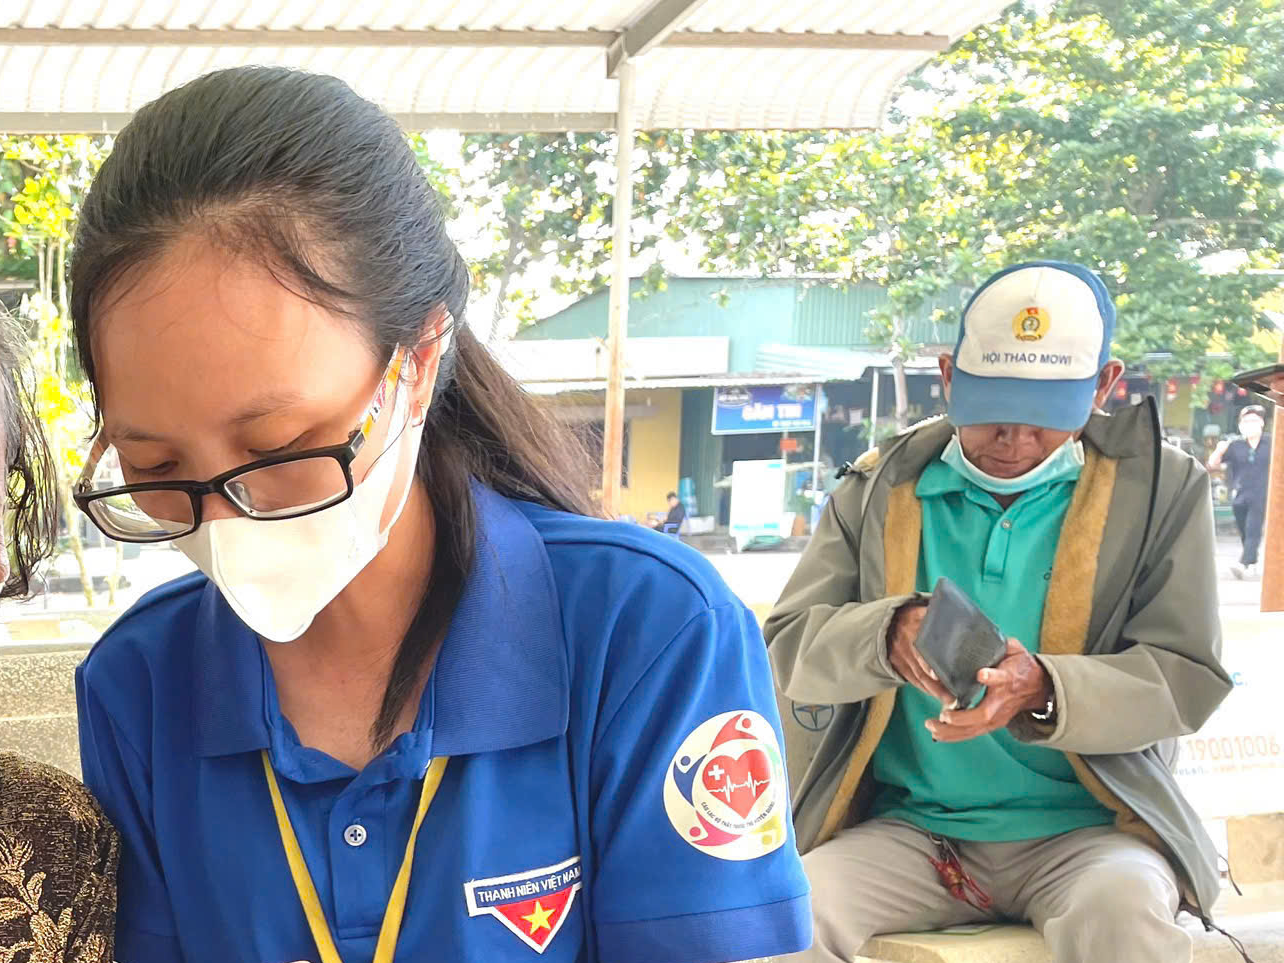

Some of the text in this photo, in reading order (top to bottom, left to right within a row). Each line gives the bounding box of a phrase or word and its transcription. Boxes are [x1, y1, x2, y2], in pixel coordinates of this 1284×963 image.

[478, 887, 516, 903] THANH
[516, 881, 540, 897] NIÊN
[540, 874, 563, 892] VIỆT
